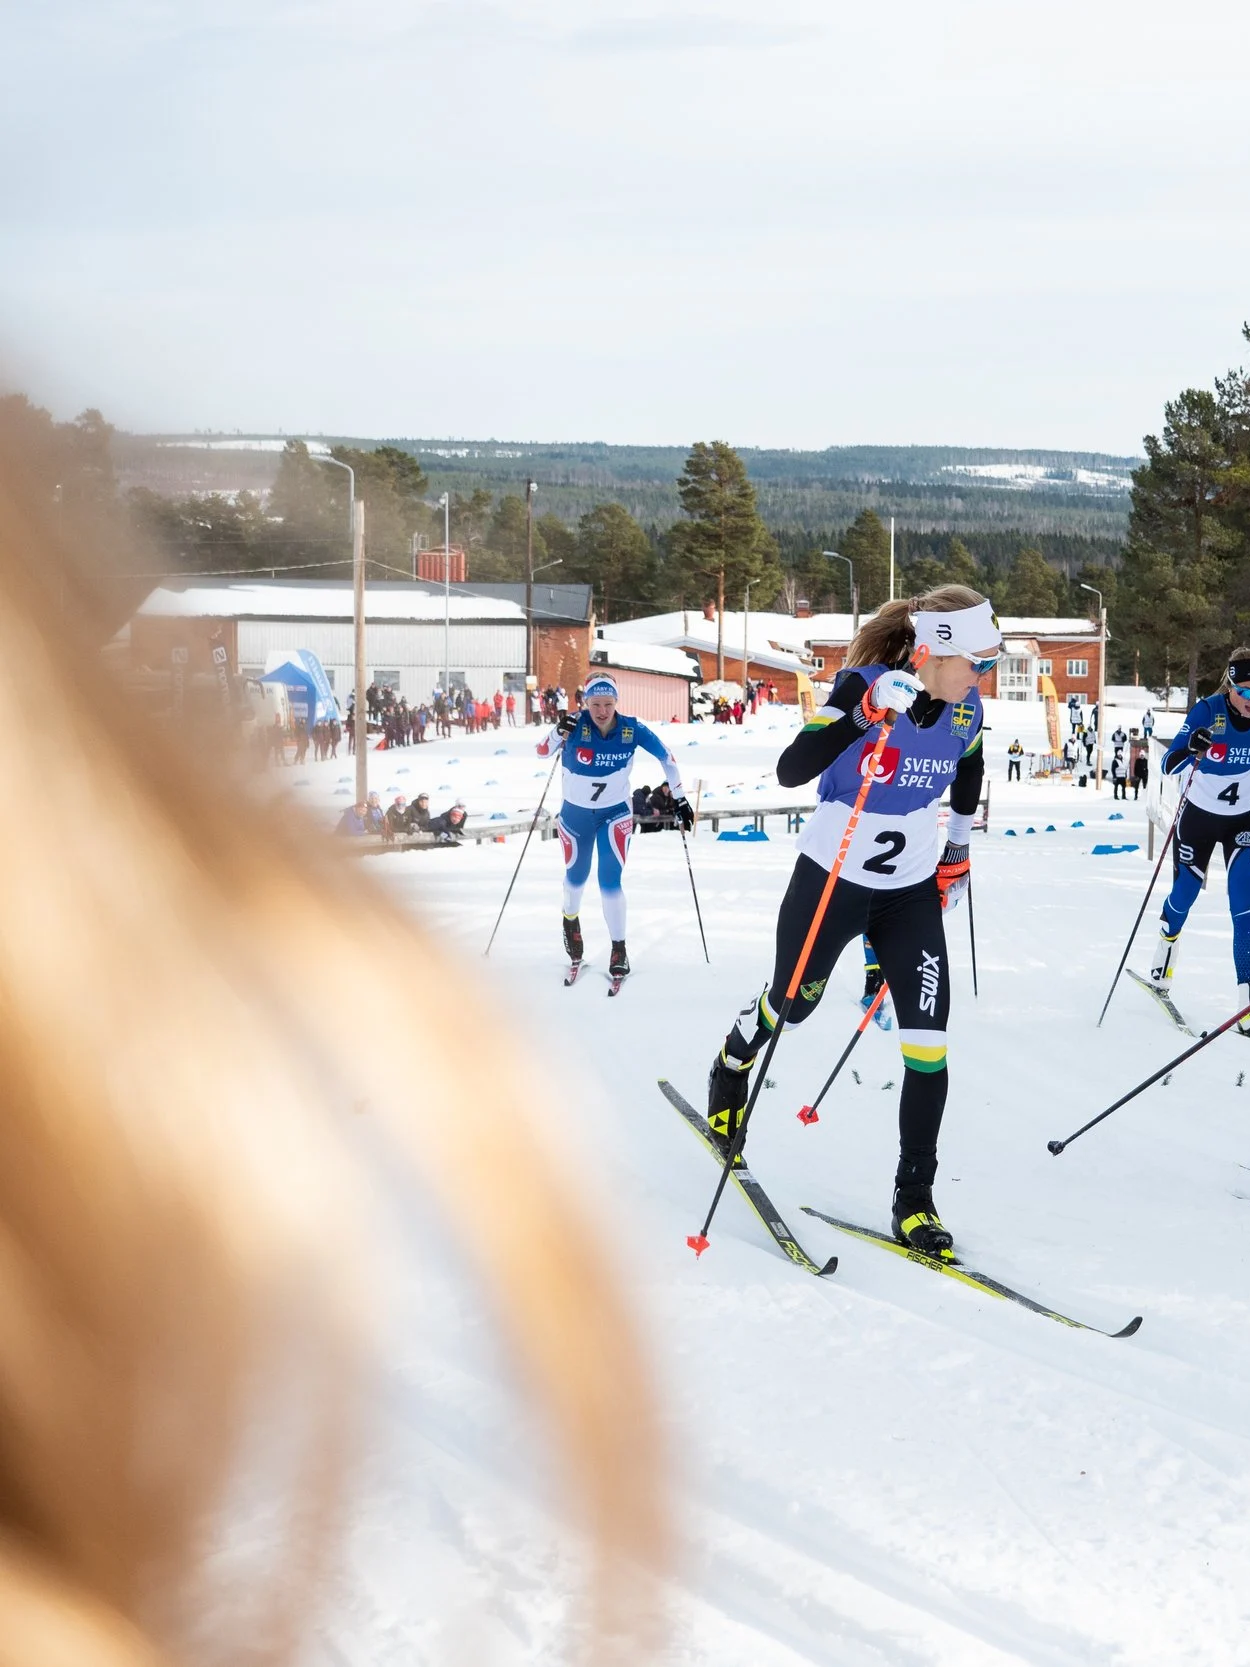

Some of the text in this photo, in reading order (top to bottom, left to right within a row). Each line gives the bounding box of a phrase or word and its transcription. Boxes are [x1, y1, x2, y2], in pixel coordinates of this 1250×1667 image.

[590, 783, 607, 801] 7
[897, 774, 933, 789] SPEL
[1217, 782, 1239, 806] 4
[862, 830, 906, 875] 2
[906, 1251, 943, 1273] FISCHER
